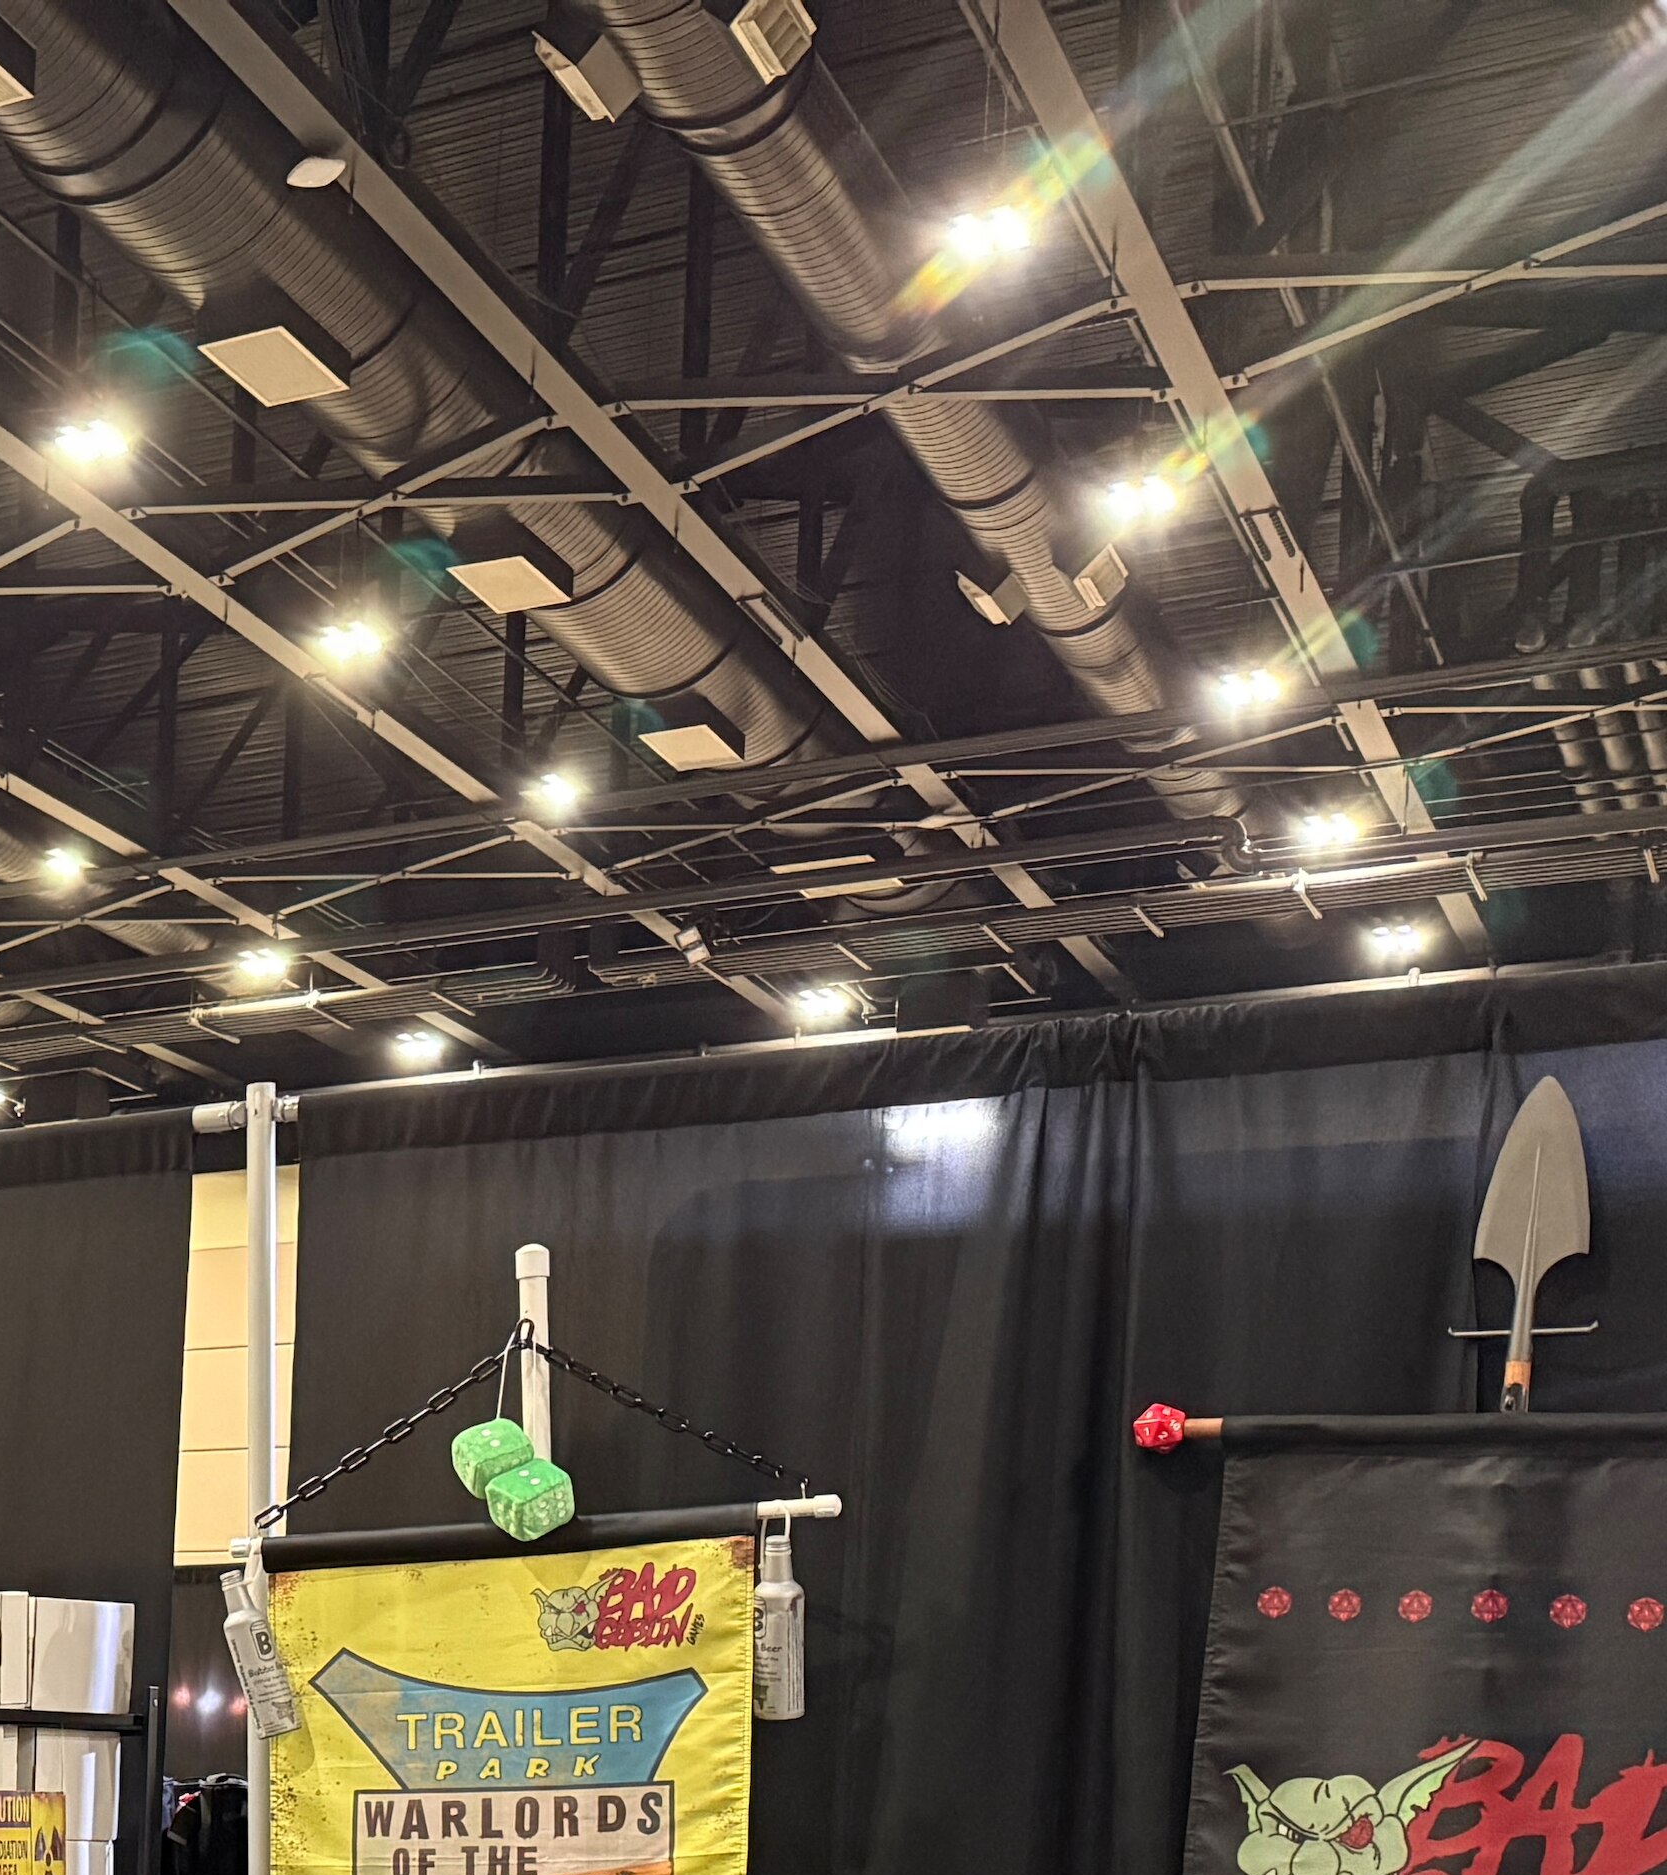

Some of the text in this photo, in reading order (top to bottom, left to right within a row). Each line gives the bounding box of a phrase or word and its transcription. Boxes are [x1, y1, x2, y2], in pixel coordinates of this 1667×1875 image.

[598, 1561, 697, 1622] BAD
[256, 1631, 273, 1656] B
[594, 1603, 694, 1652] GOBLIN
[686, 1613, 706, 1646] GAMES
[396, 1703, 643, 1751] TRAILER
[435, 1754, 602, 1781] PARK
[365, 1791, 663, 1840] WARLORDS
